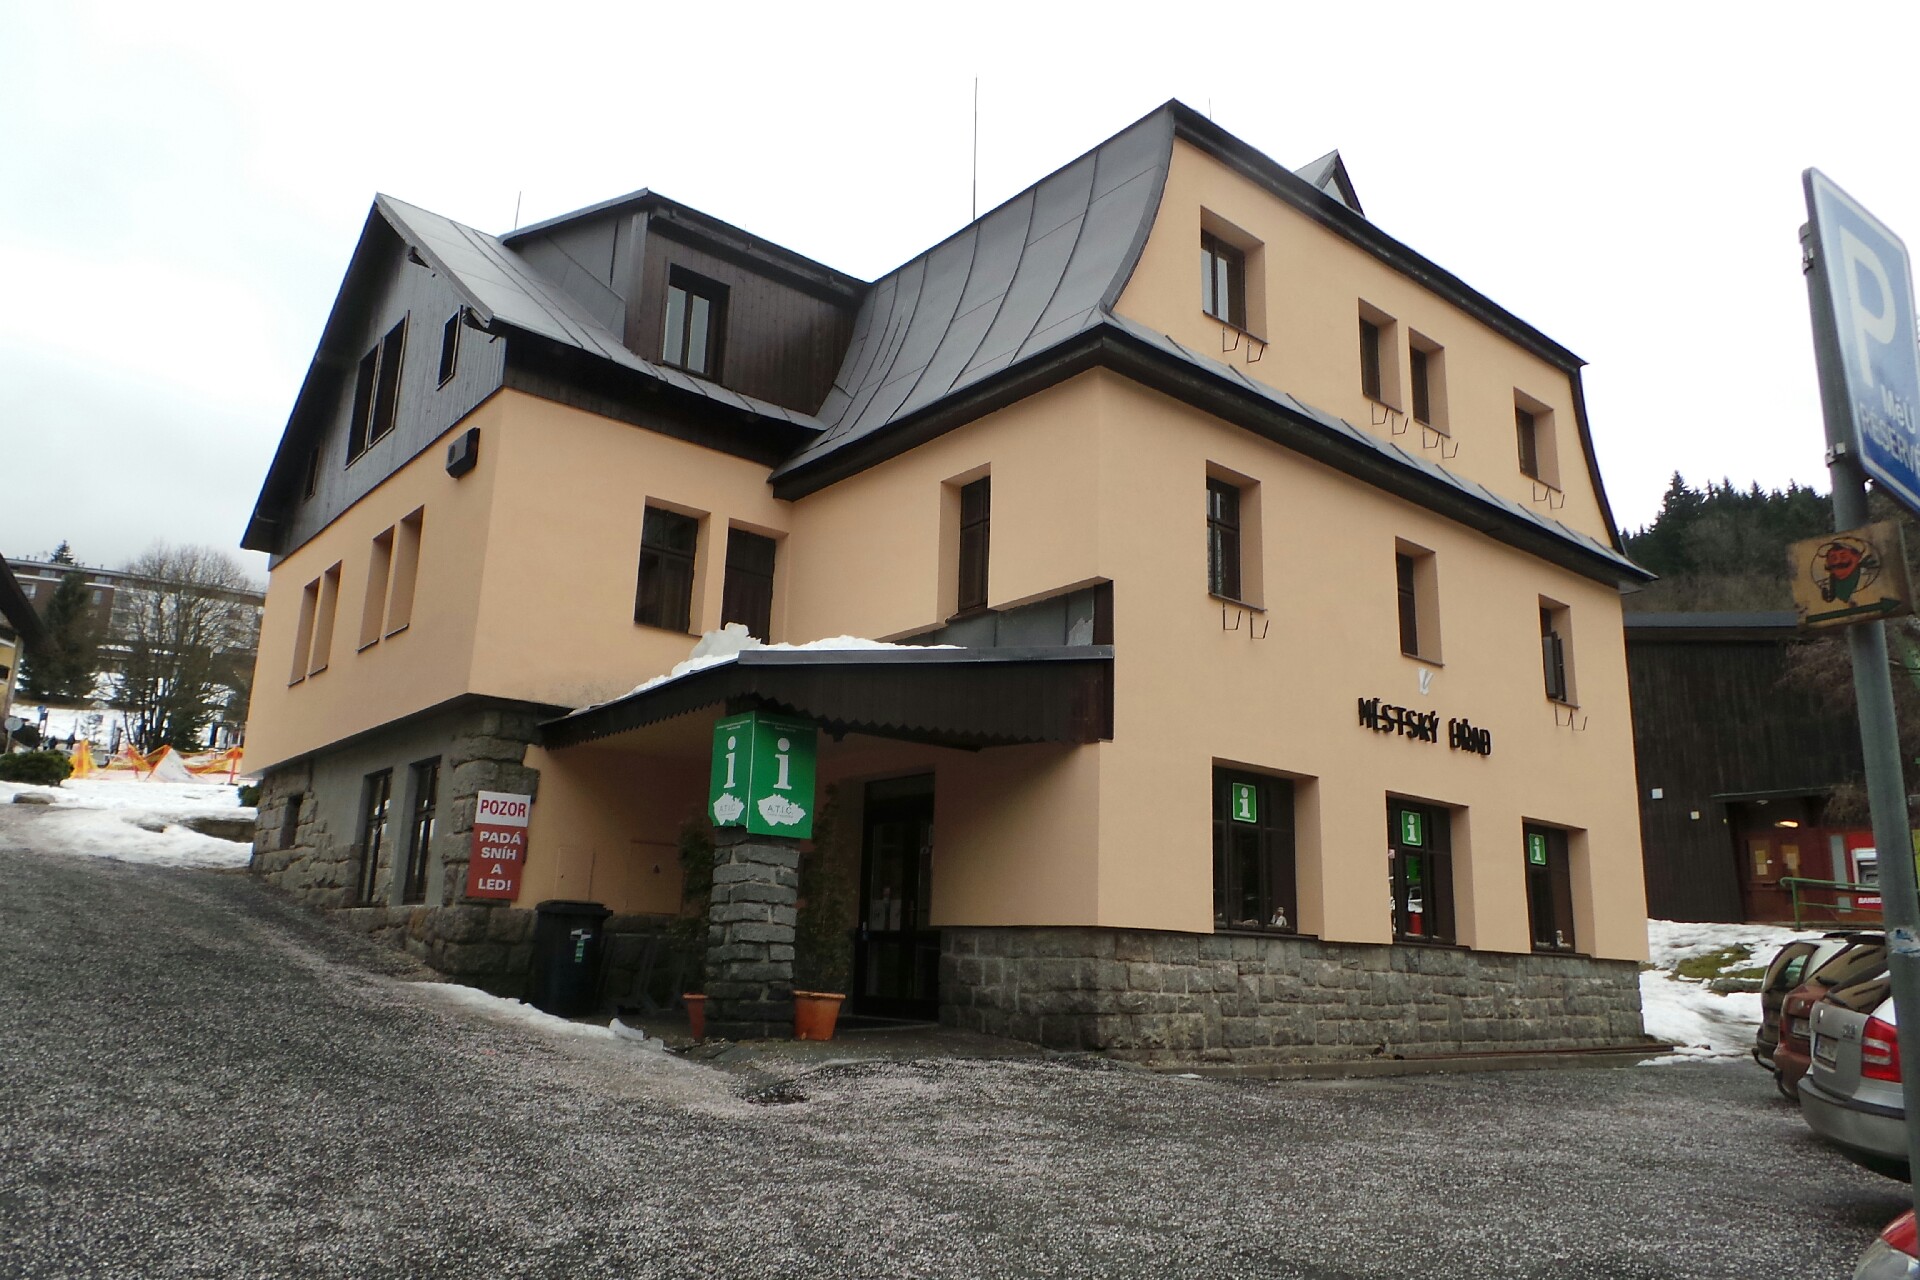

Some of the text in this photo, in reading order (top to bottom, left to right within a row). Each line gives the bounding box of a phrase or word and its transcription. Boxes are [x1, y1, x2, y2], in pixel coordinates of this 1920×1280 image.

[1839, 225, 1897, 389] P
[1358, 697, 1491, 756] MĚSTSKÝ ÚŘAD
[480, 800, 526, 817] POZOR
[480, 831, 520, 845] PADÁ
[481, 846, 516, 860] SNÍH
[491, 864, 502, 874] A
[478, 878, 511, 891] LED!
